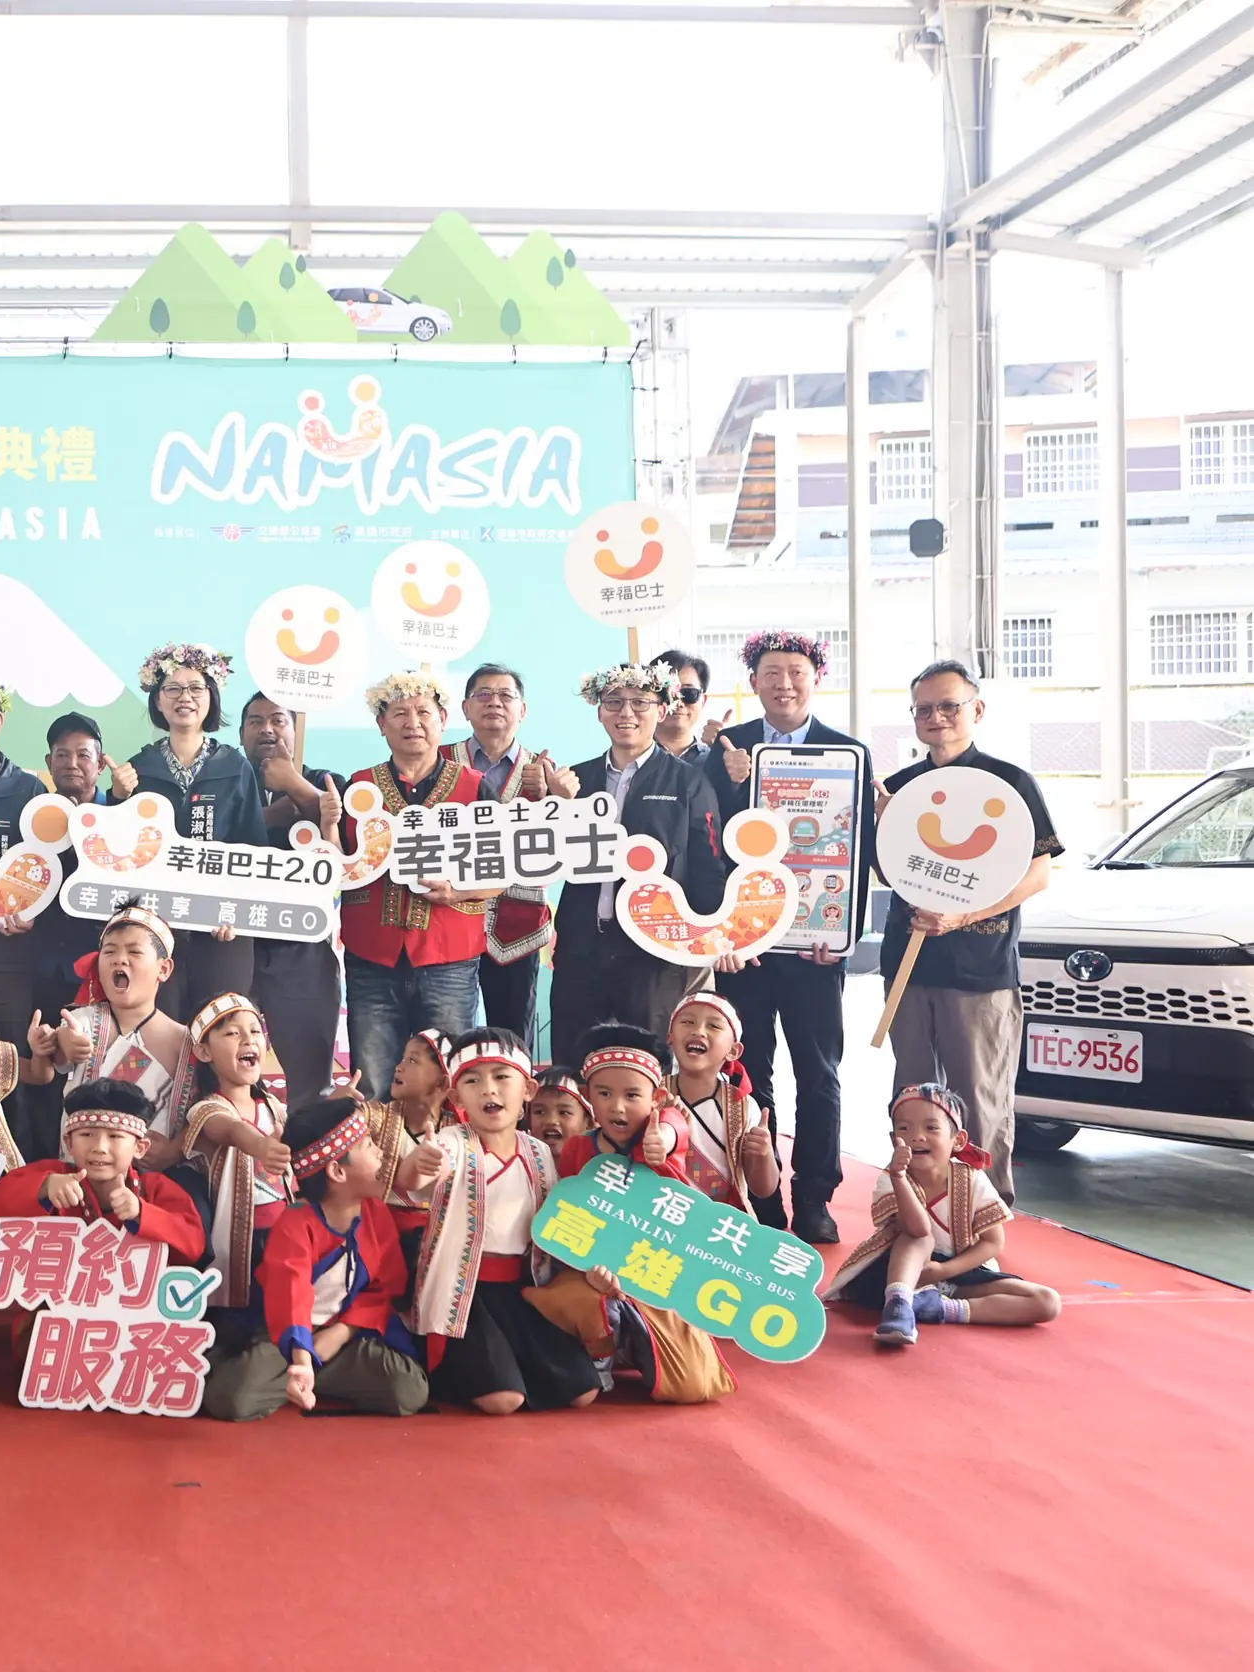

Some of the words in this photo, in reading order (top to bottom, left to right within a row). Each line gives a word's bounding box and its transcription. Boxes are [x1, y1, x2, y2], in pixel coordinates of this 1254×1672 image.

[600, 582, 664, 602] 幸福巴士
[402, 619, 459, 640] 幸福巴士
[276, 667, 335, 688] 幸福巴士
[402, 796, 609, 830] 幸福巴士2.0
[166, 844, 333, 886] 幸福巴士2.0
[393, 823, 618, 880] 幸福巴士
[907, 854, 980, 891] 幸福巴士
[655, 923, 690, 940] 高雄
[593, 1159, 815, 1279] 幸福共享
[586, 1194, 677, 1245] SHANLIN
[684, 1243, 763, 1286] HAPPINESS
[766, 1281, 797, 1301] BUS
[24, 1316, 210, 1411] 服務
